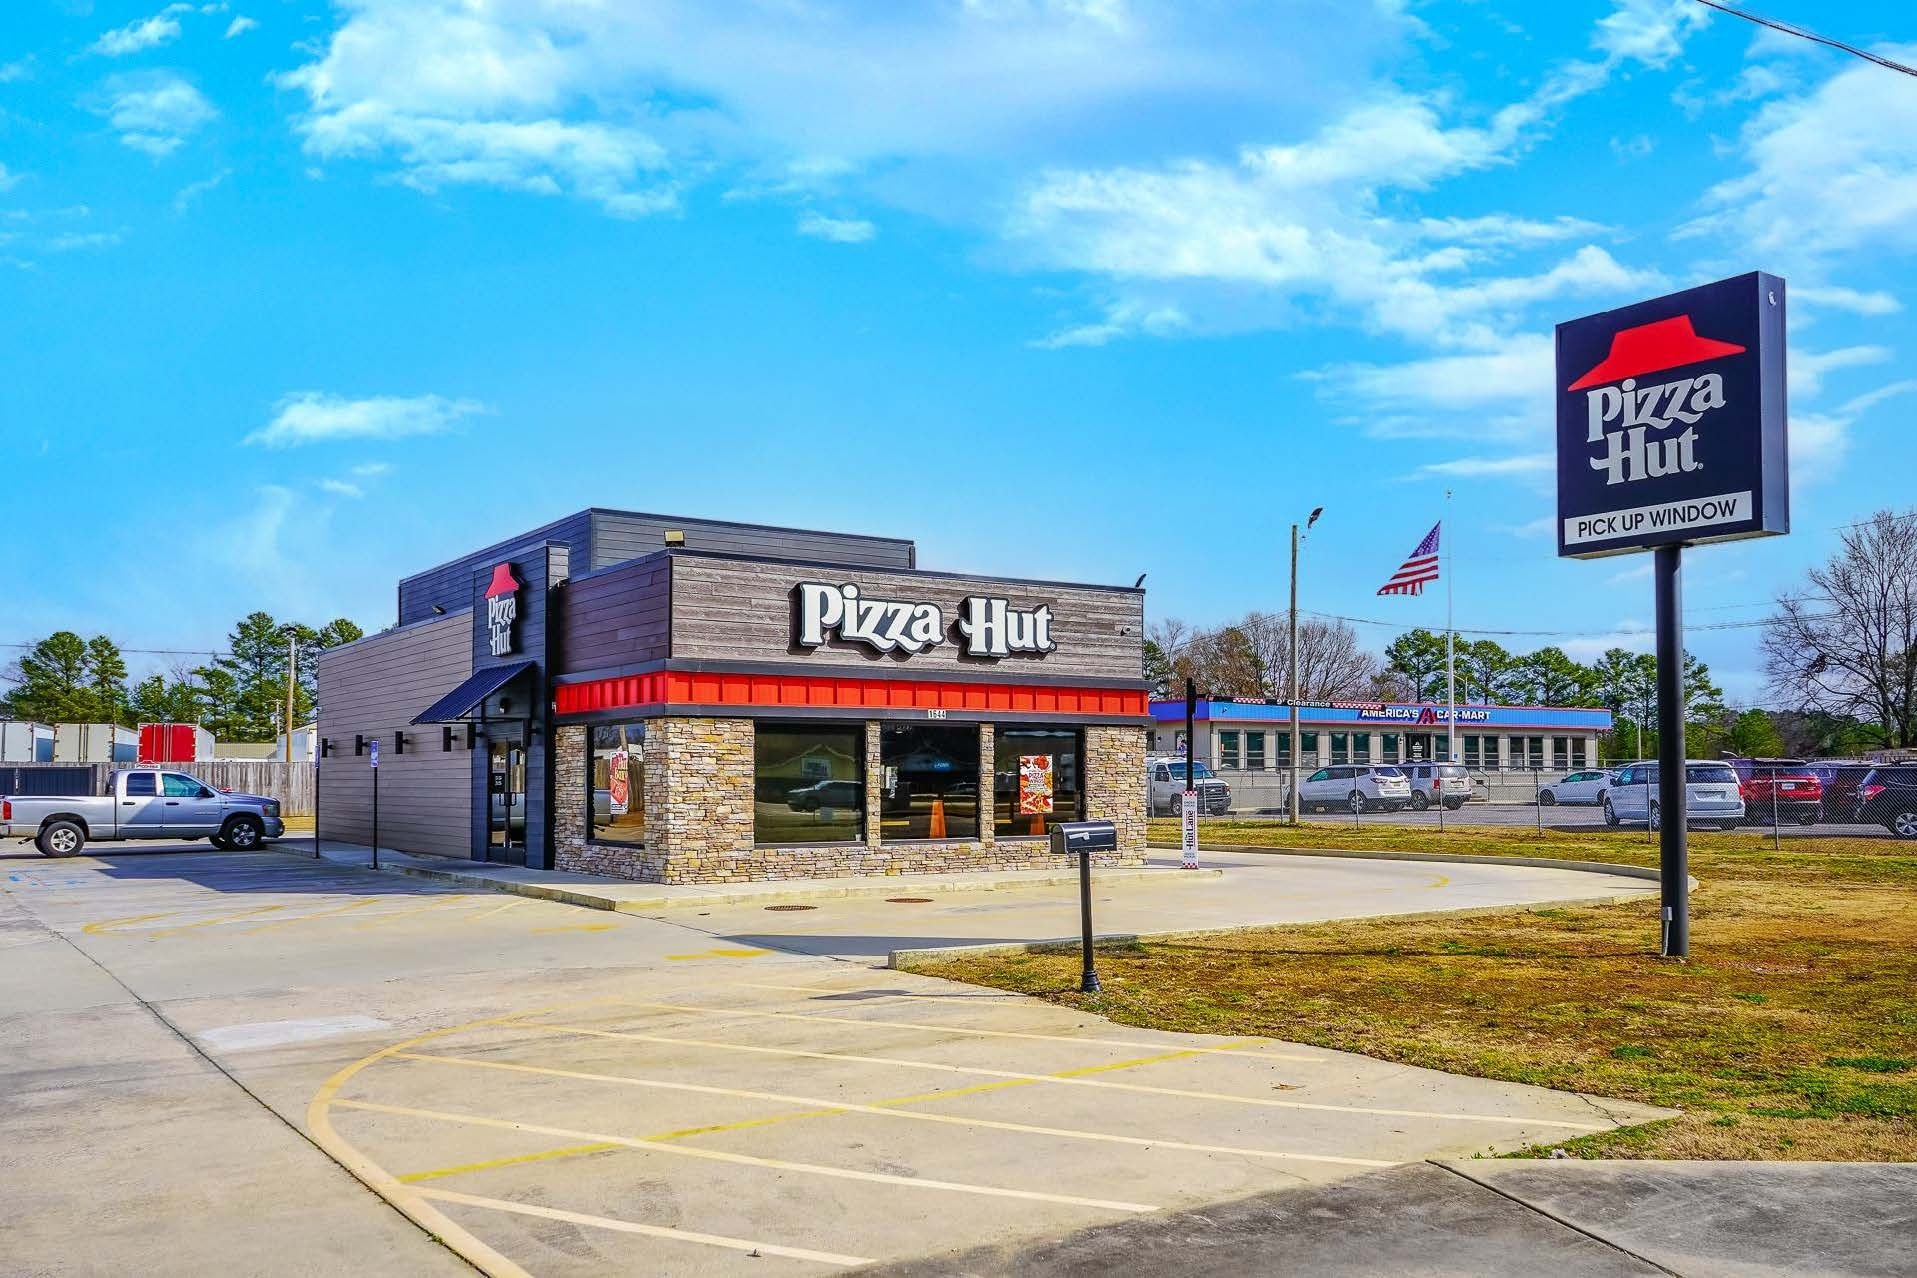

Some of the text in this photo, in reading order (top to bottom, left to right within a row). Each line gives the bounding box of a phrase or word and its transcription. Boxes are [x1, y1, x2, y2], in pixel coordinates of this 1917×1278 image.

[1586, 373, 1726, 442] Pizza
[1590, 427, 1700, 485] Hut
[1578, 499, 1737, 538] PICK UP WINDOW
[488, 595, 517, 629] Pizza
[801, 583, 1053, 655] Pizza Hut
[489, 624, 512, 656] Hut
[1287, 699, 1331, 707] Clearance
[1361, 708, 1419, 718] AMERICA'S
